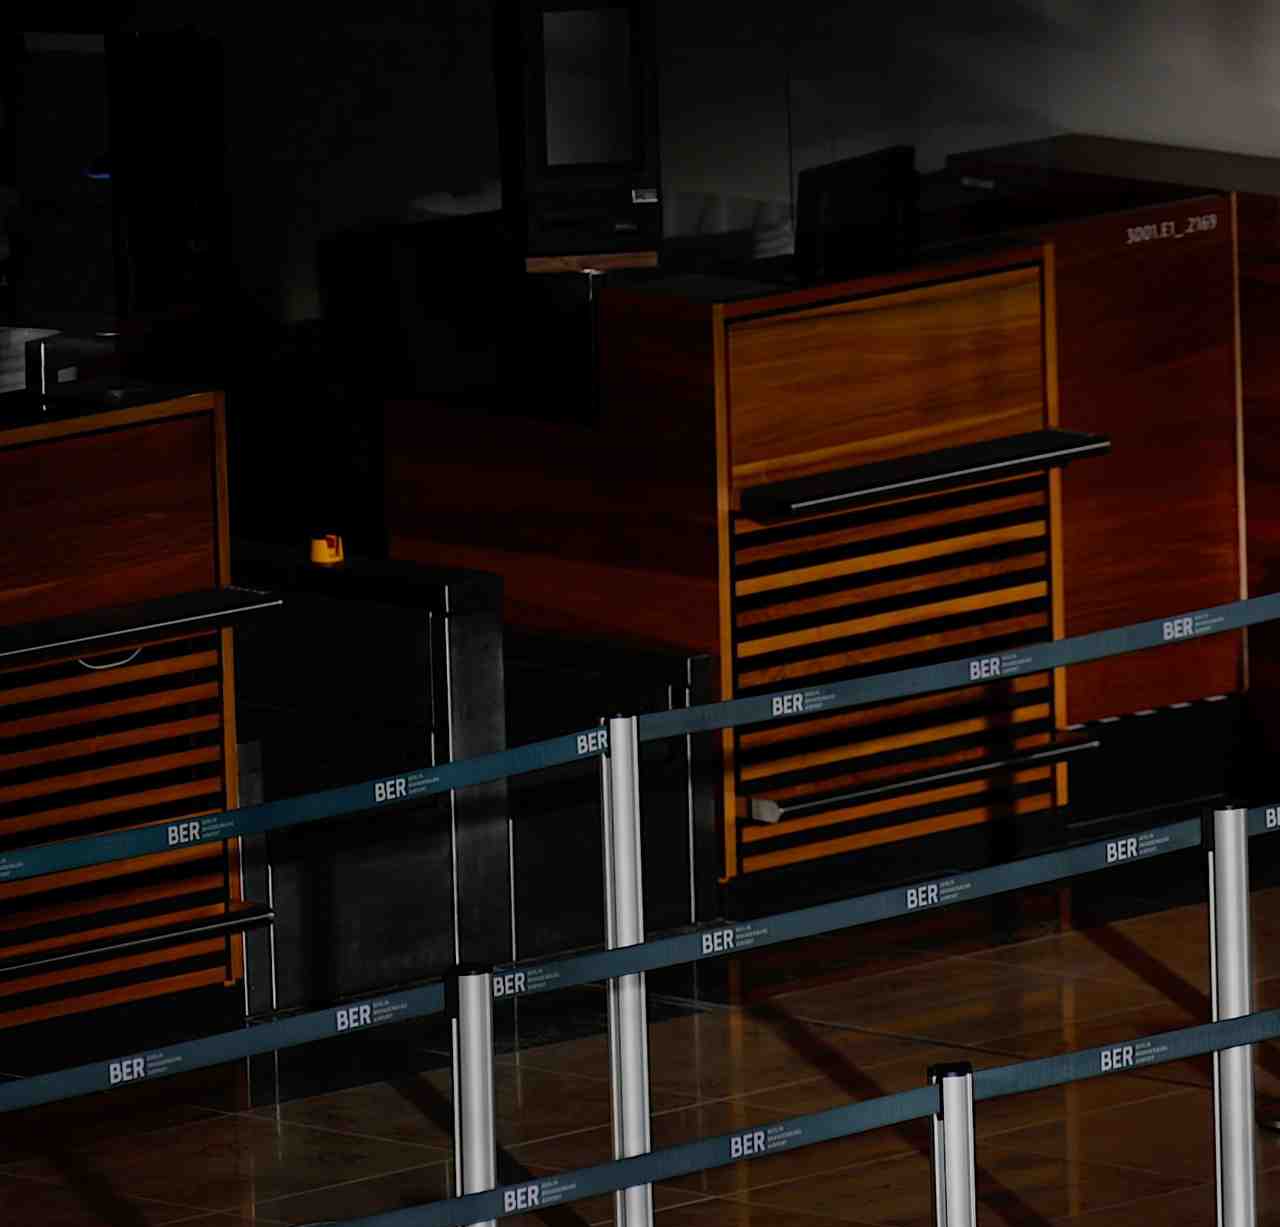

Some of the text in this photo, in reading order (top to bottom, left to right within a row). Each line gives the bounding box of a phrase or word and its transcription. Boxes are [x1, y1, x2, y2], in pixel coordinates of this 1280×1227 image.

[1163, 617, 1193, 640] BER
[970, 656, 1000, 680] BER
[772, 691, 804, 717] BER
[577, 728, 607, 755] BER
[374, 775, 406, 802] BER
[168, 819, 200, 847] BER
[1107, 837, 1138, 862] BER
[907, 883, 939, 909] BER
[702, 927, 735, 955] BER
[493, 970, 526, 997] BER
[336, 1004, 372, 1031] BER
[109, 1056, 145, 1085] BER
[1101, 1045, 1134, 1072] BER
[730, 1132, 765, 1158] BER
[503, 1185, 539, 1212] BER
